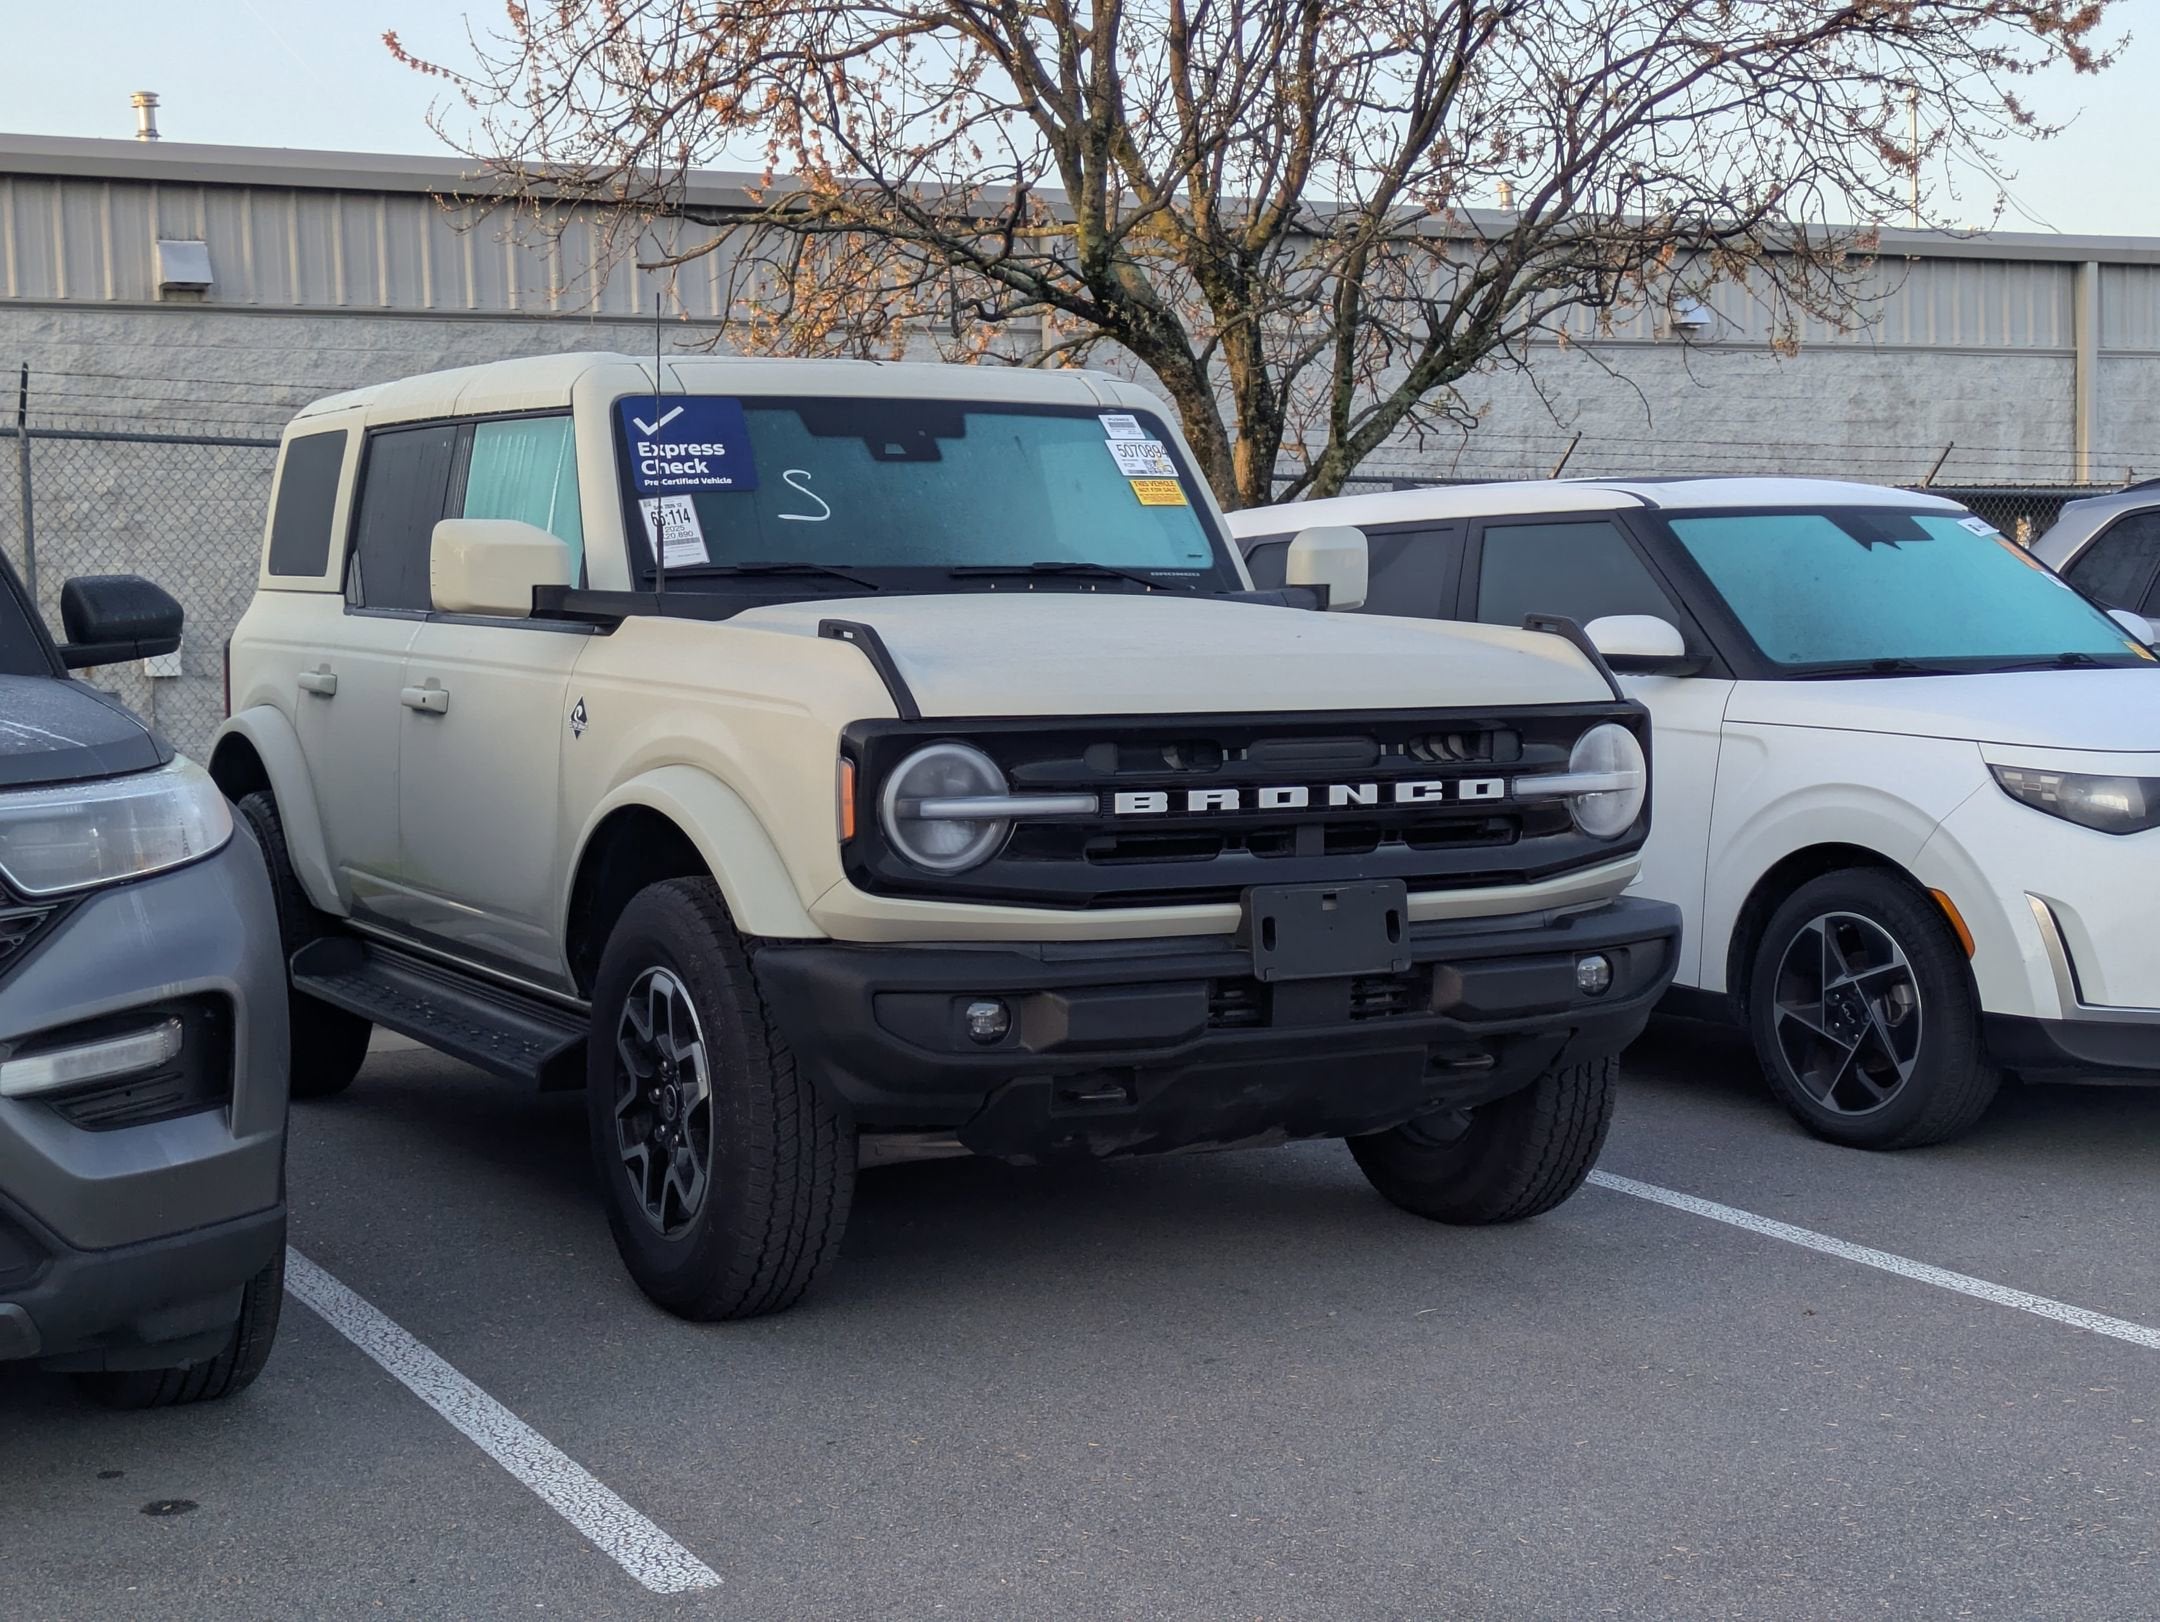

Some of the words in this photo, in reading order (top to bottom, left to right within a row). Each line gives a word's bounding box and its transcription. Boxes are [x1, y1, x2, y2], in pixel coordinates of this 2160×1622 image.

[637, 441, 726, 459] Express
[640, 458, 710, 475] Check
[644, 477, 700, 486] Pre-Certified
[700, 477, 733, 485] Vehicle
[777, 468, 831, 522] S
[1114, 778, 1505, 815] BRONCO
